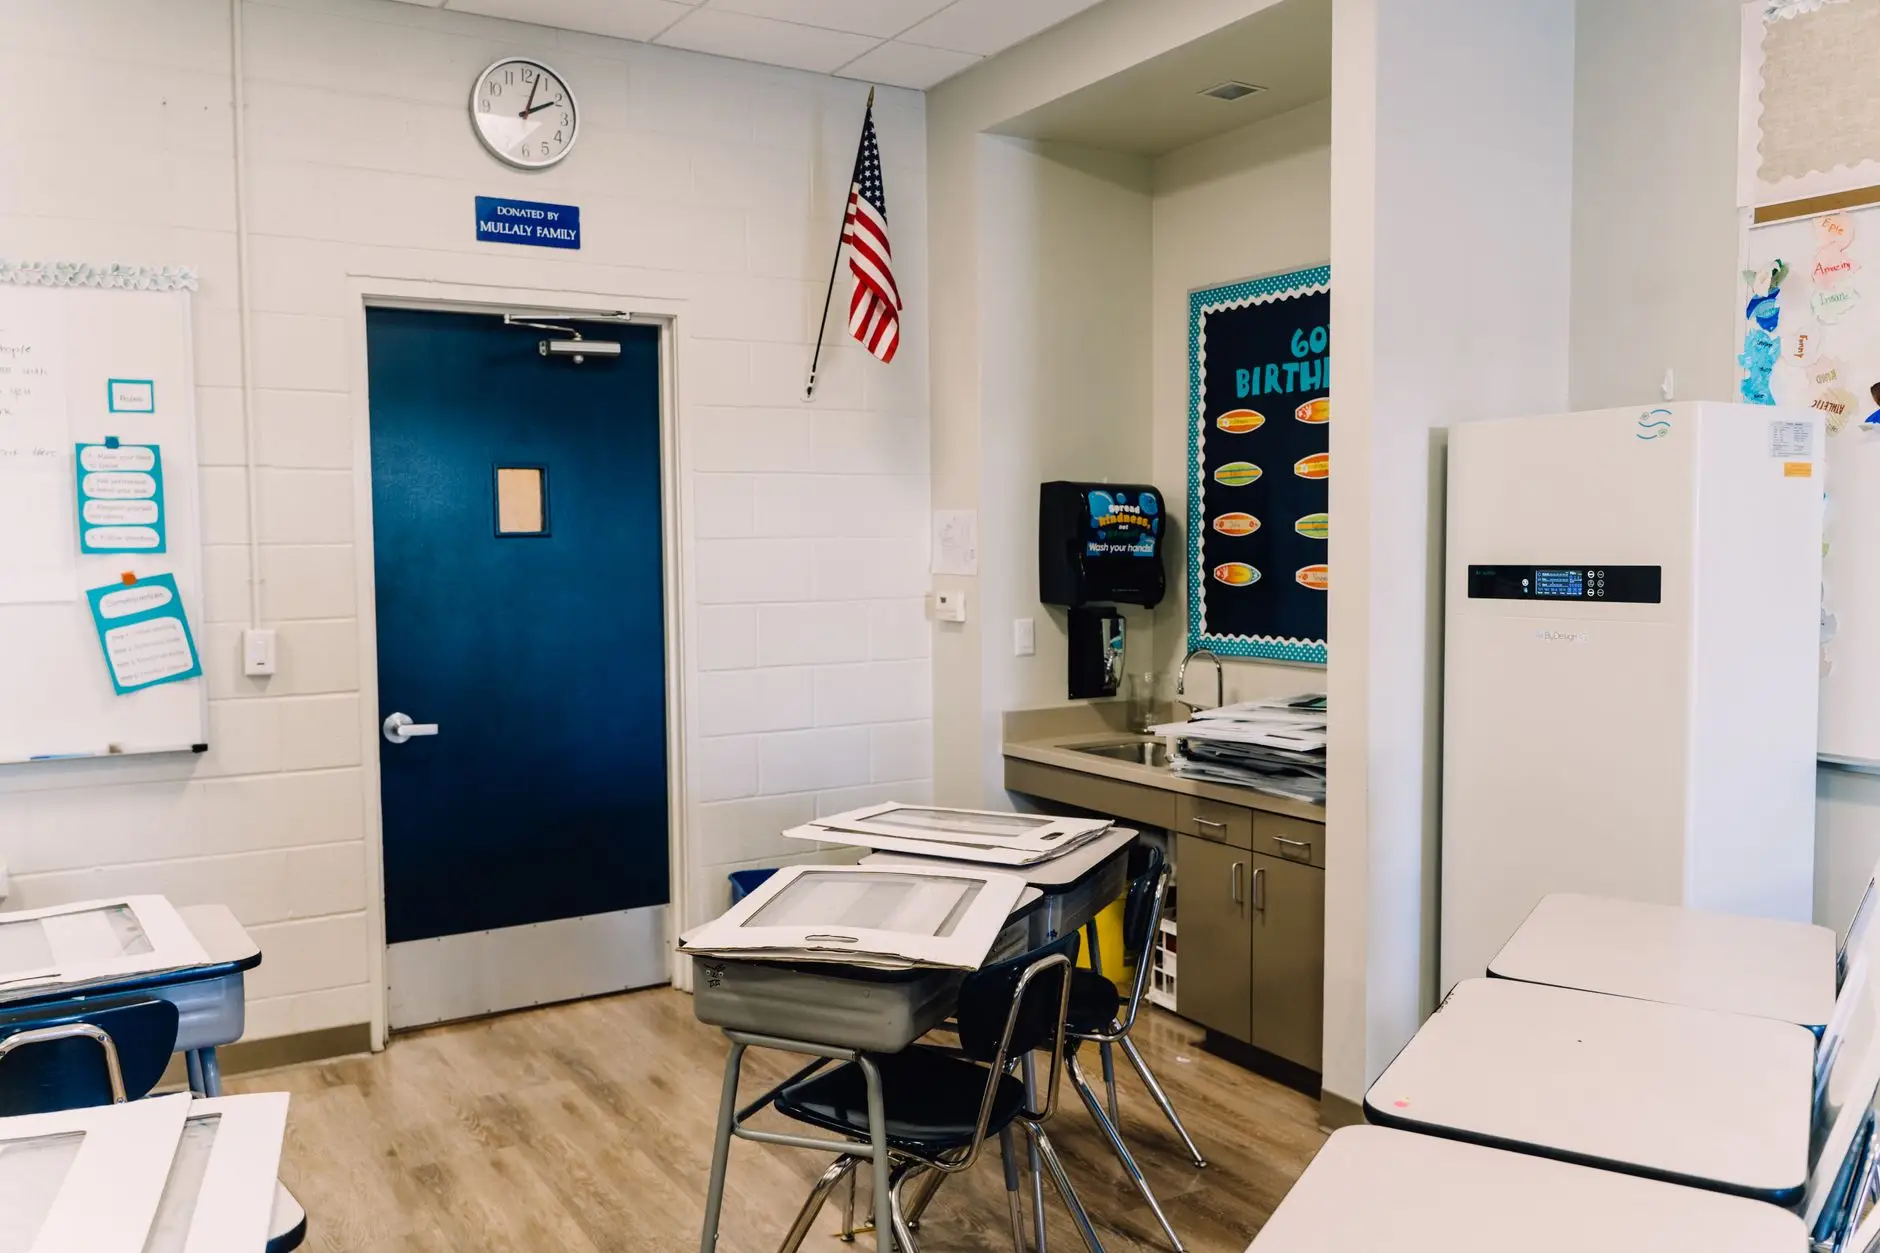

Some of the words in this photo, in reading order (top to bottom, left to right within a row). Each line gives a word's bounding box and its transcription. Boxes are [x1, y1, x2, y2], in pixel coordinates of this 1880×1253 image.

[505, 70, 513, 86] 11
[521, 68, 533, 84] 12
[489, 81, 502, 97] 10
[482, 99, 491, 113] 9
[554, 93, 563, 108] 2
[560, 112, 569, 127] 3
[553, 130, 563, 144] 4
[521, 144, 530, 158] 6
[540, 141, 550, 156] 5
[497, 206, 545, 219] DONATED
[547, 211, 559, 221] BY
[480, 220, 533, 236] MULLALY
[536, 226, 577, 240] FAMILY
[1810, 399, 1846, 415] ATHLETIC
[1109, 504, 1140, 514] spread
[1089, 542, 1109, 552] Wash
[1109, 544, 1127, 554] your
[1127, 543, 1153, 553] hands!
